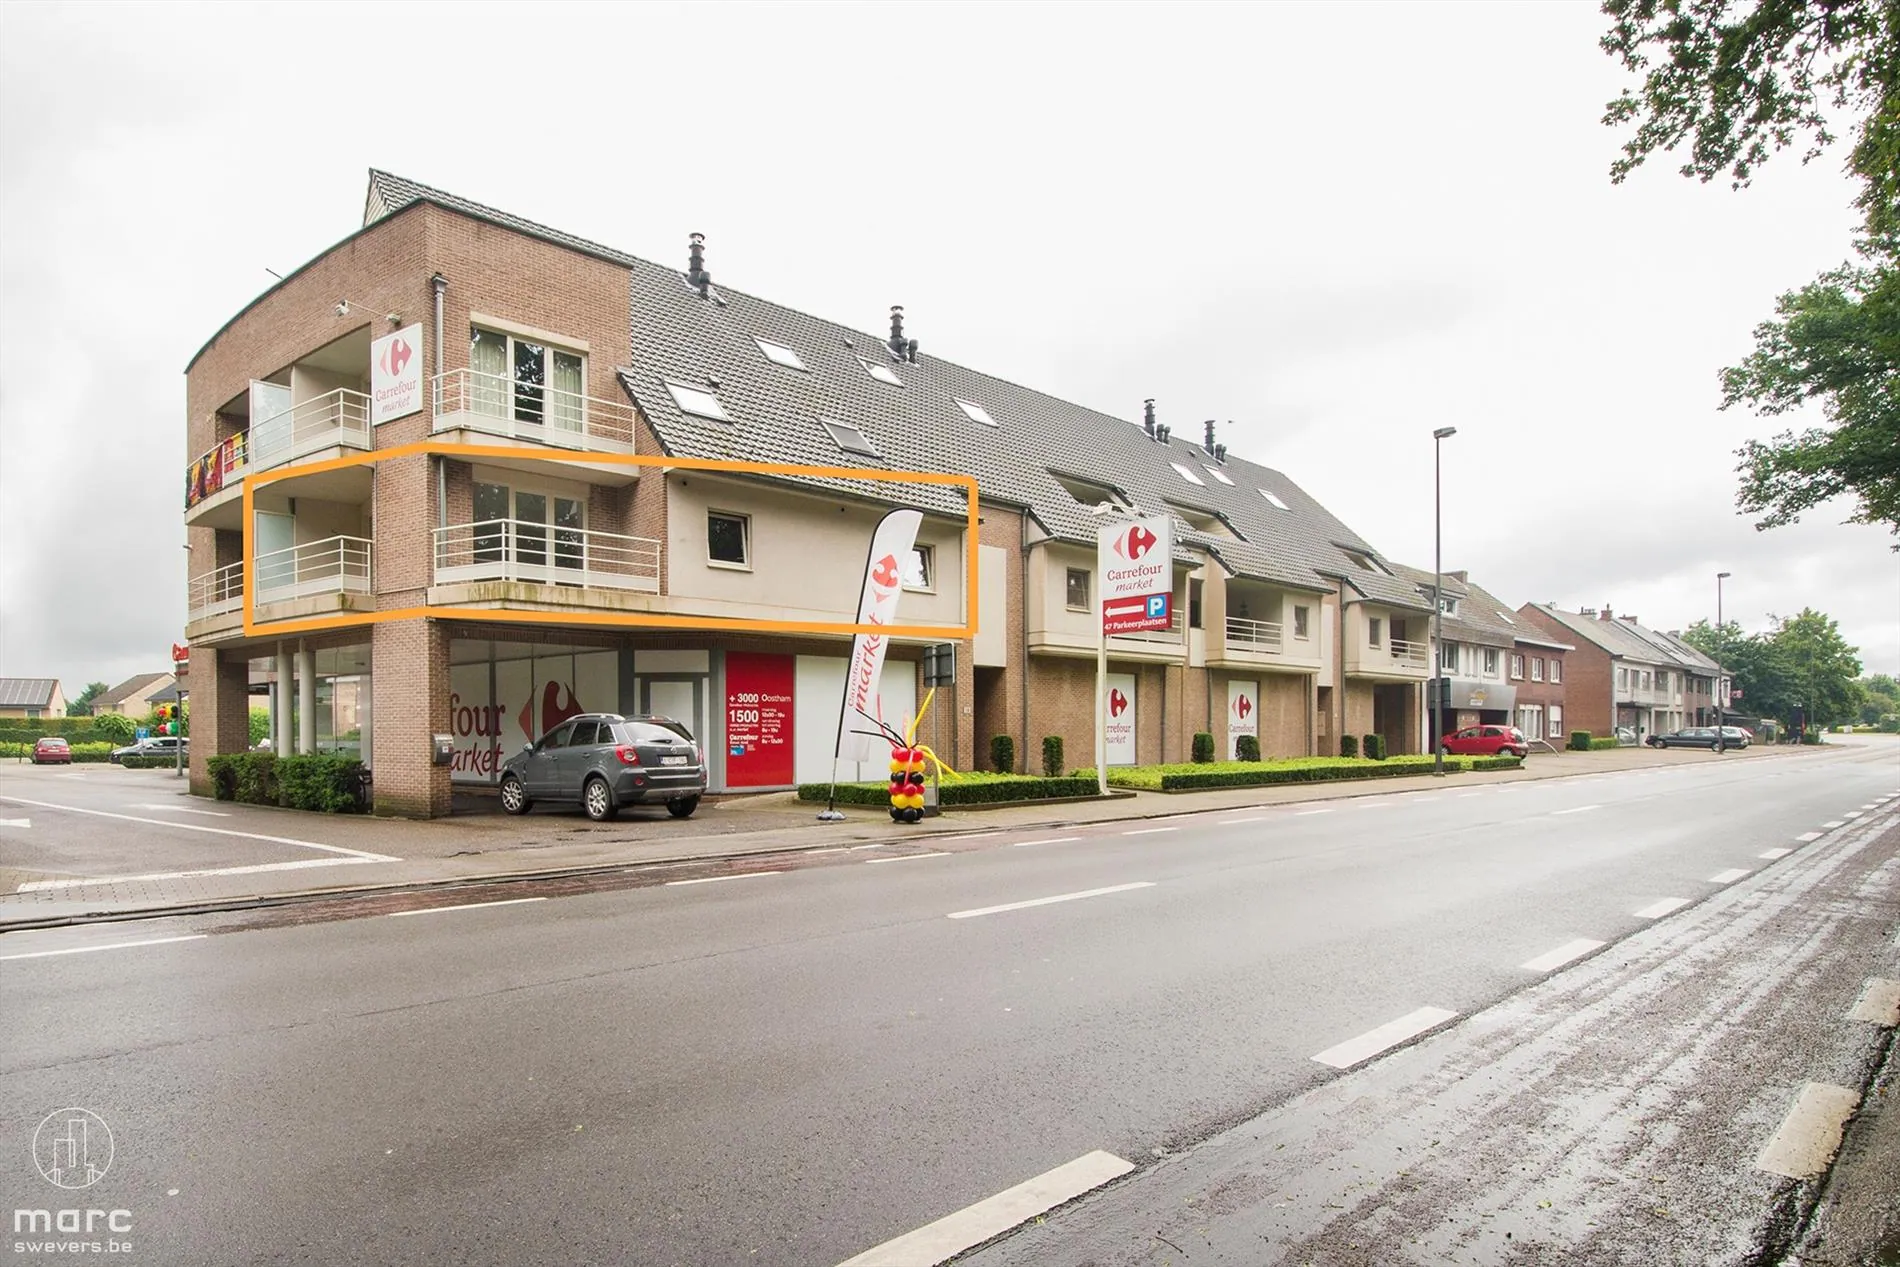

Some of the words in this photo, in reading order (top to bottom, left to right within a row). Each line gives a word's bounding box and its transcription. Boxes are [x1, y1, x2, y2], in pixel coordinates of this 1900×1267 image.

[376, 379, 416, 402] Carrefour
[381, 396, 410, 413] market
[1107, 564, 1163, 581] Carrefour
[1115, 578, 1153, 592] market
[1150, 597, 1163, 615] P
[1104, 622, 1112, 630] 47
[1113, 618, 1167, 629] Parkeerplaatsen
[848, 651, 861, 707] Carrefour
[737, 693, 759, 703] 3000
[761, 694, 792, 702] Oostham
[450, 693, 506, 737] four
[729, 709, 759, 723] 1500
[1106, 722, 1131, 733] rrefour
[450, 742, 505, 776] arket
